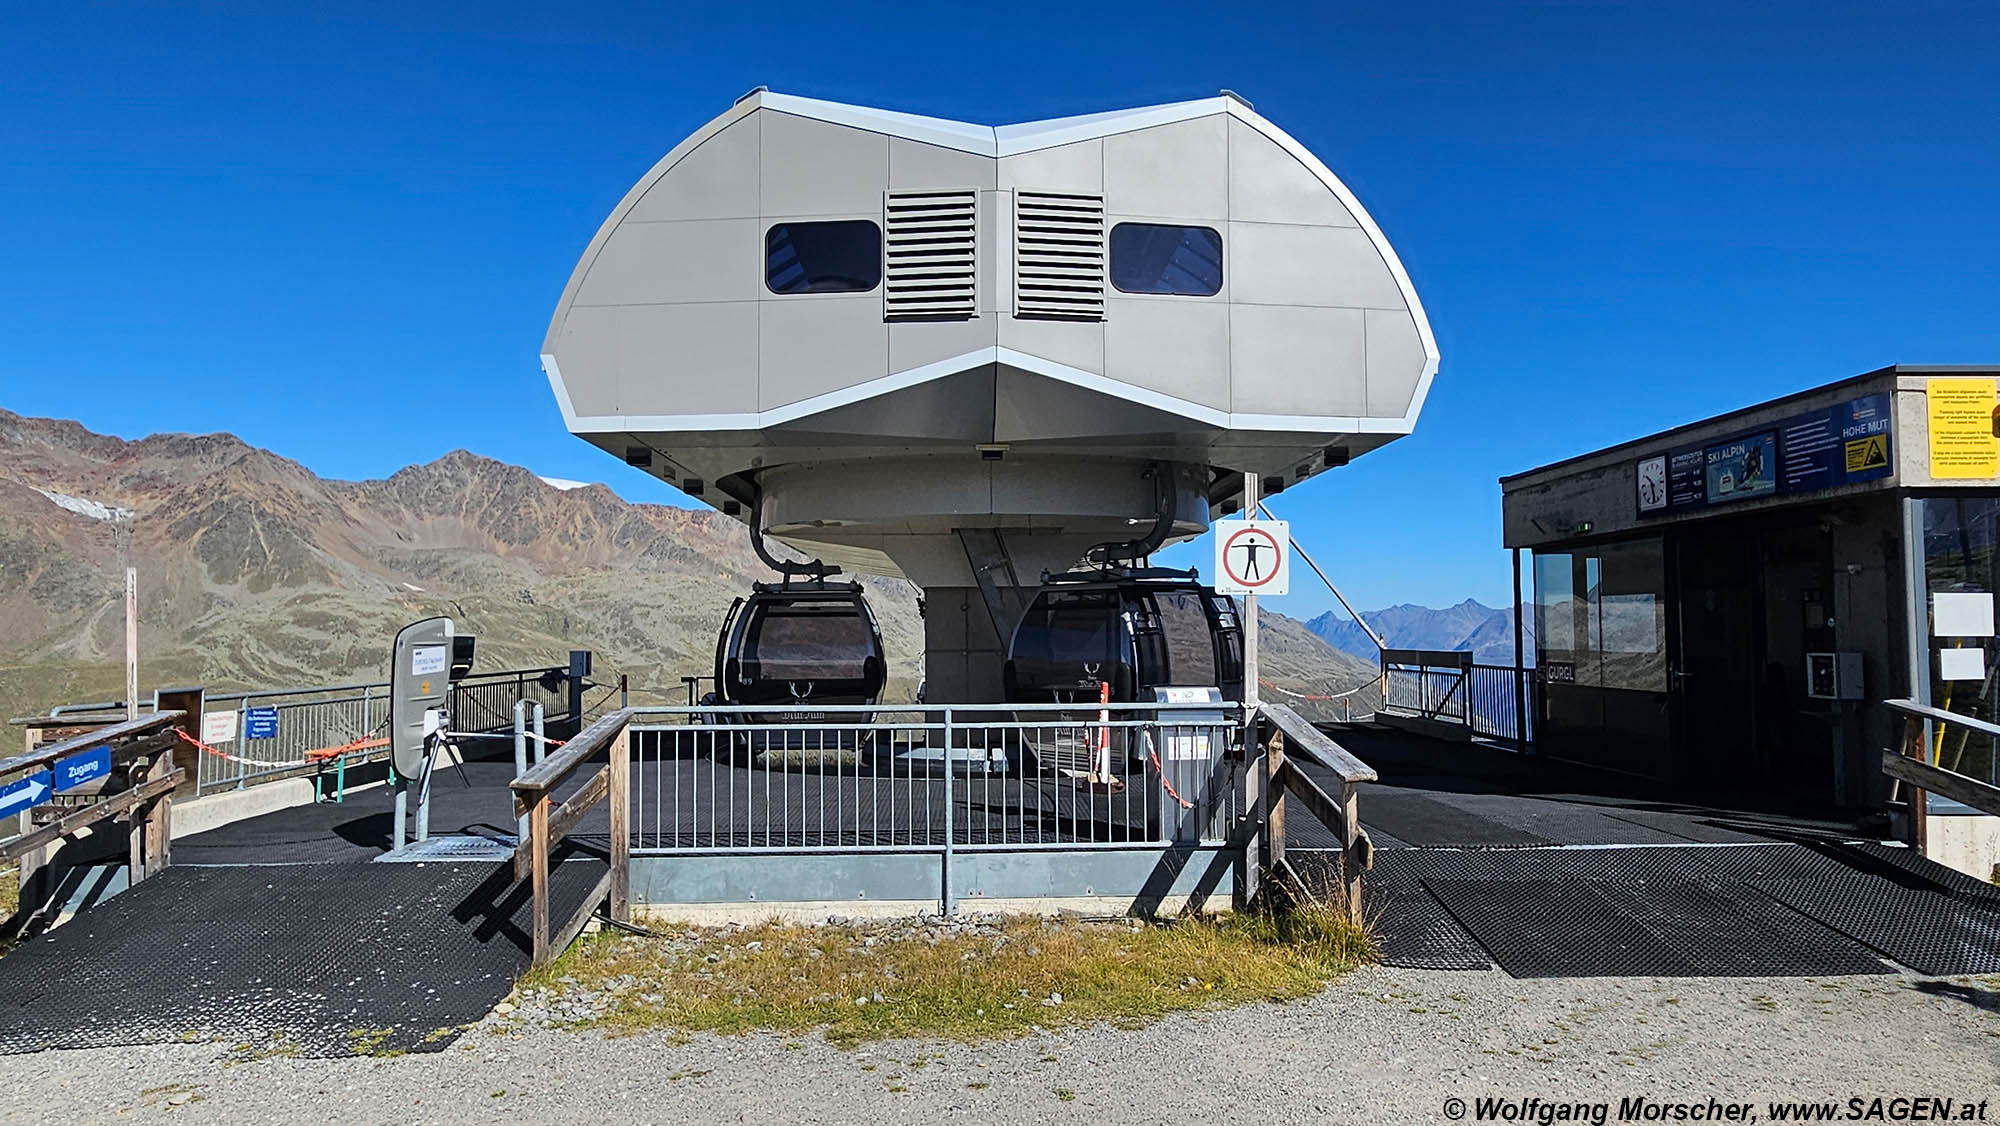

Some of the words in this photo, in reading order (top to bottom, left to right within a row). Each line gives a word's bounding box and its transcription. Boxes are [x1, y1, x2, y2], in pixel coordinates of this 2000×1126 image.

[1843, 424, 1867, 439] HOHE
[1868, 419, 1888, 433] MUT
[1708, 451, 1720, 464] SKI
[1721, 444, 1745, 461] ALPIN
[1549, 665, 1574, 680] GURGL
[68, 760, 99, 778] Zugang
